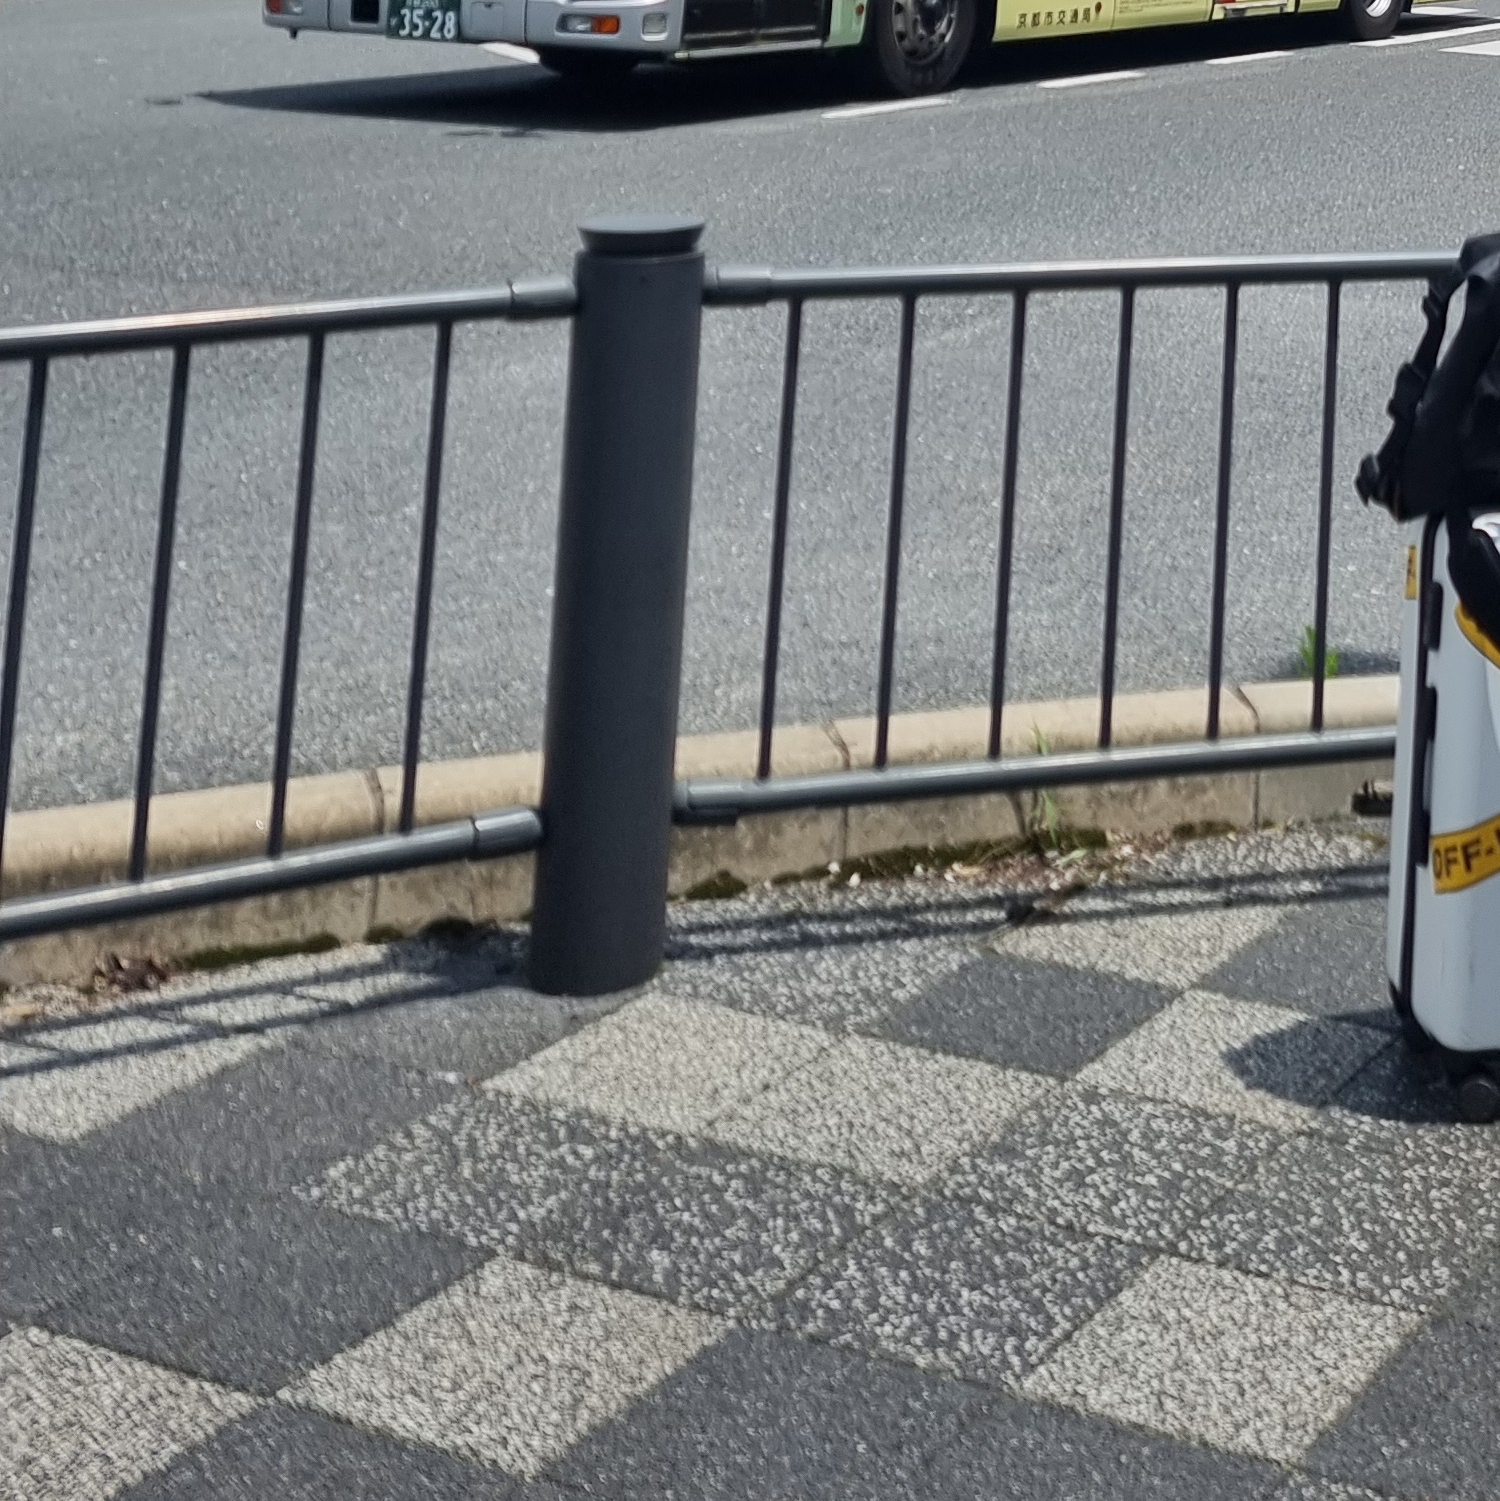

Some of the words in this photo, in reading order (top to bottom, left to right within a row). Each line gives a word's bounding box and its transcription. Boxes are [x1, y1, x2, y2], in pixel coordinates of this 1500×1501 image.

[1016, 7, 1092, 30] 京都市交通局
